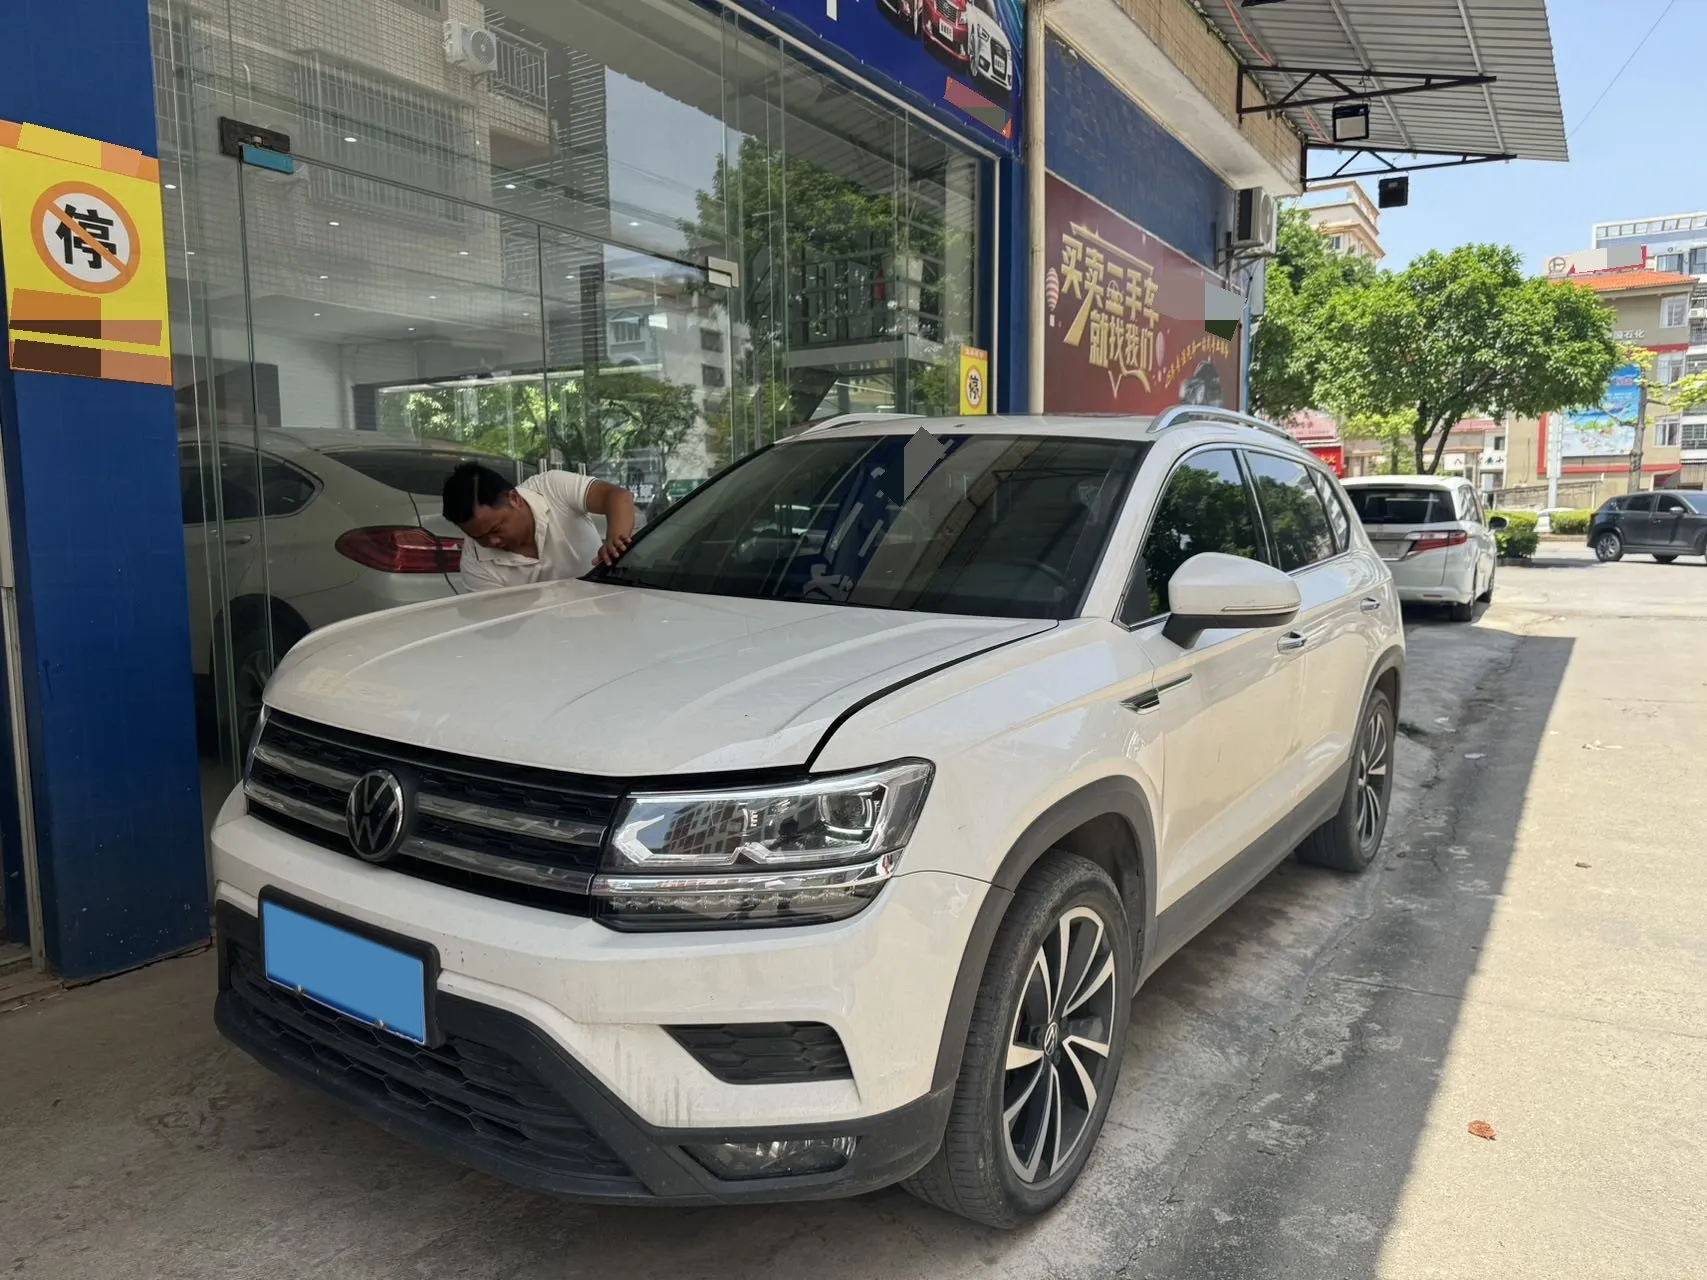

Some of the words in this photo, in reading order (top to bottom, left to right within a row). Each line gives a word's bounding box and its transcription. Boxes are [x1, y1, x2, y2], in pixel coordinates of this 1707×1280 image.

[55, 203, 118, 270] 停
[1060, 231, 1159, 335] 买卖二手车
[1088, 309, 1154, 373] 就找我们
